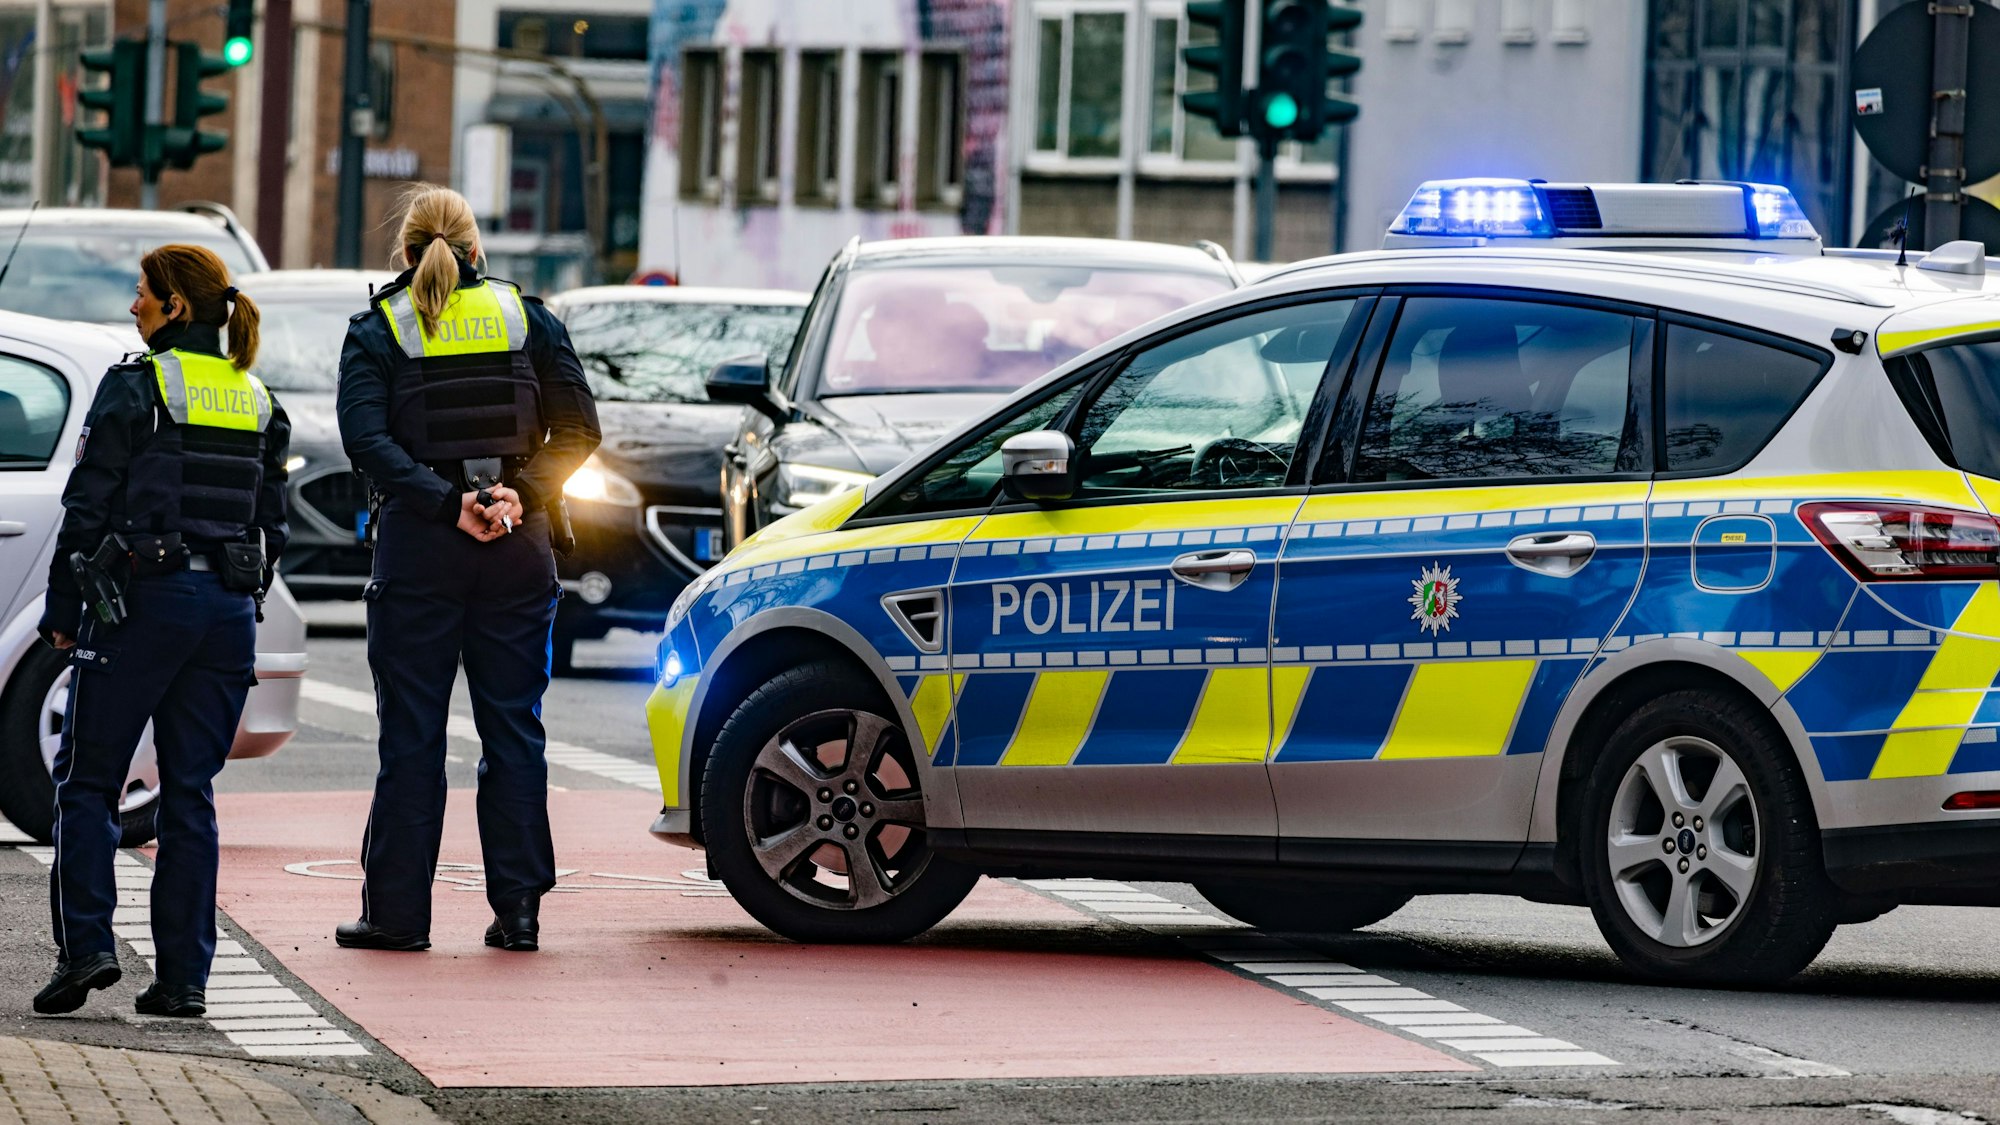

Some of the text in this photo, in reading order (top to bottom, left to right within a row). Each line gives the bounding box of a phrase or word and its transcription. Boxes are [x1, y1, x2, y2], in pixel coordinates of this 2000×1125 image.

[427, 316, 502, 343] OLIZEI
[188, 386, 255, 416] POLIZEI
[991, 579, 1175, 635] POLIZEI
